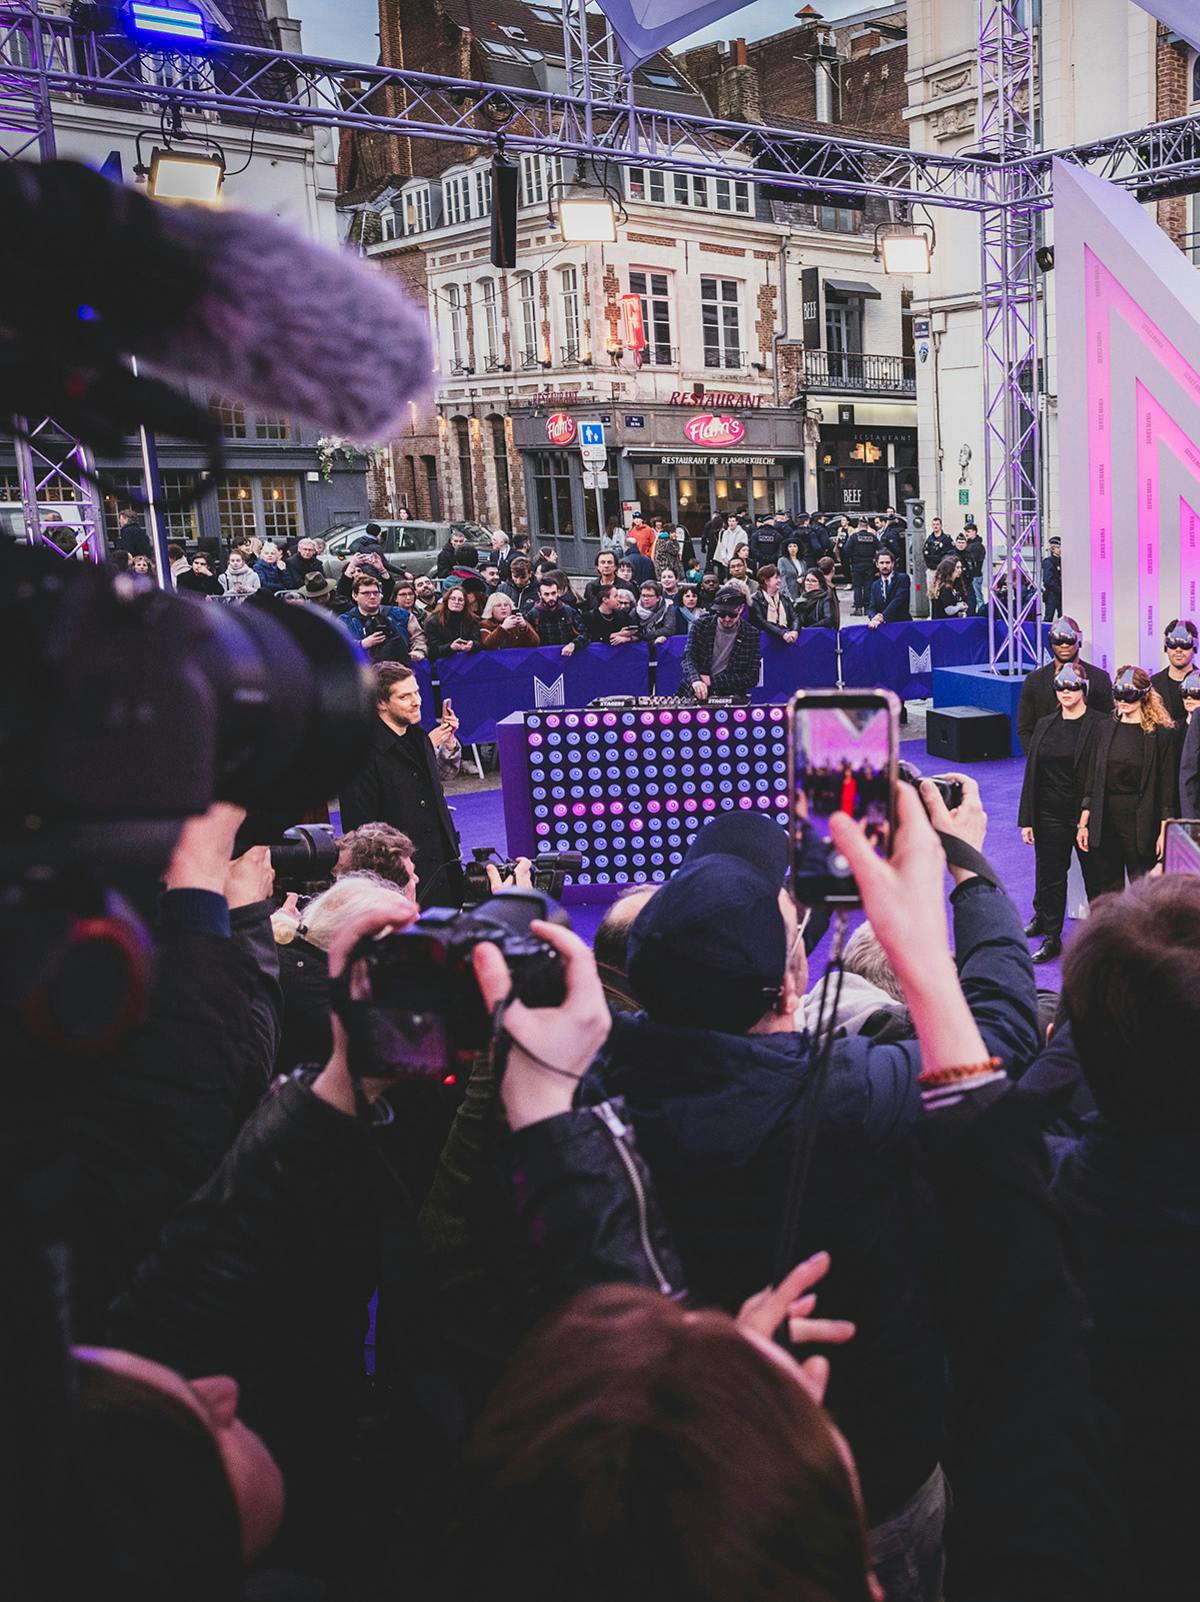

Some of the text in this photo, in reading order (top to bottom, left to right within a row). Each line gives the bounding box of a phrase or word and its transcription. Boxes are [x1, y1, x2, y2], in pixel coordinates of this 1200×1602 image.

[803, 301, 817, 320] BEEF
[668, 391, 764, 409] RESTAURANT
[689, 418, 740, 441] Flam's
[661, 456, 707, 465] RESTAURANT
[709, 457, 718, 465] DE
[843, 489, 862, 503] BEEF
